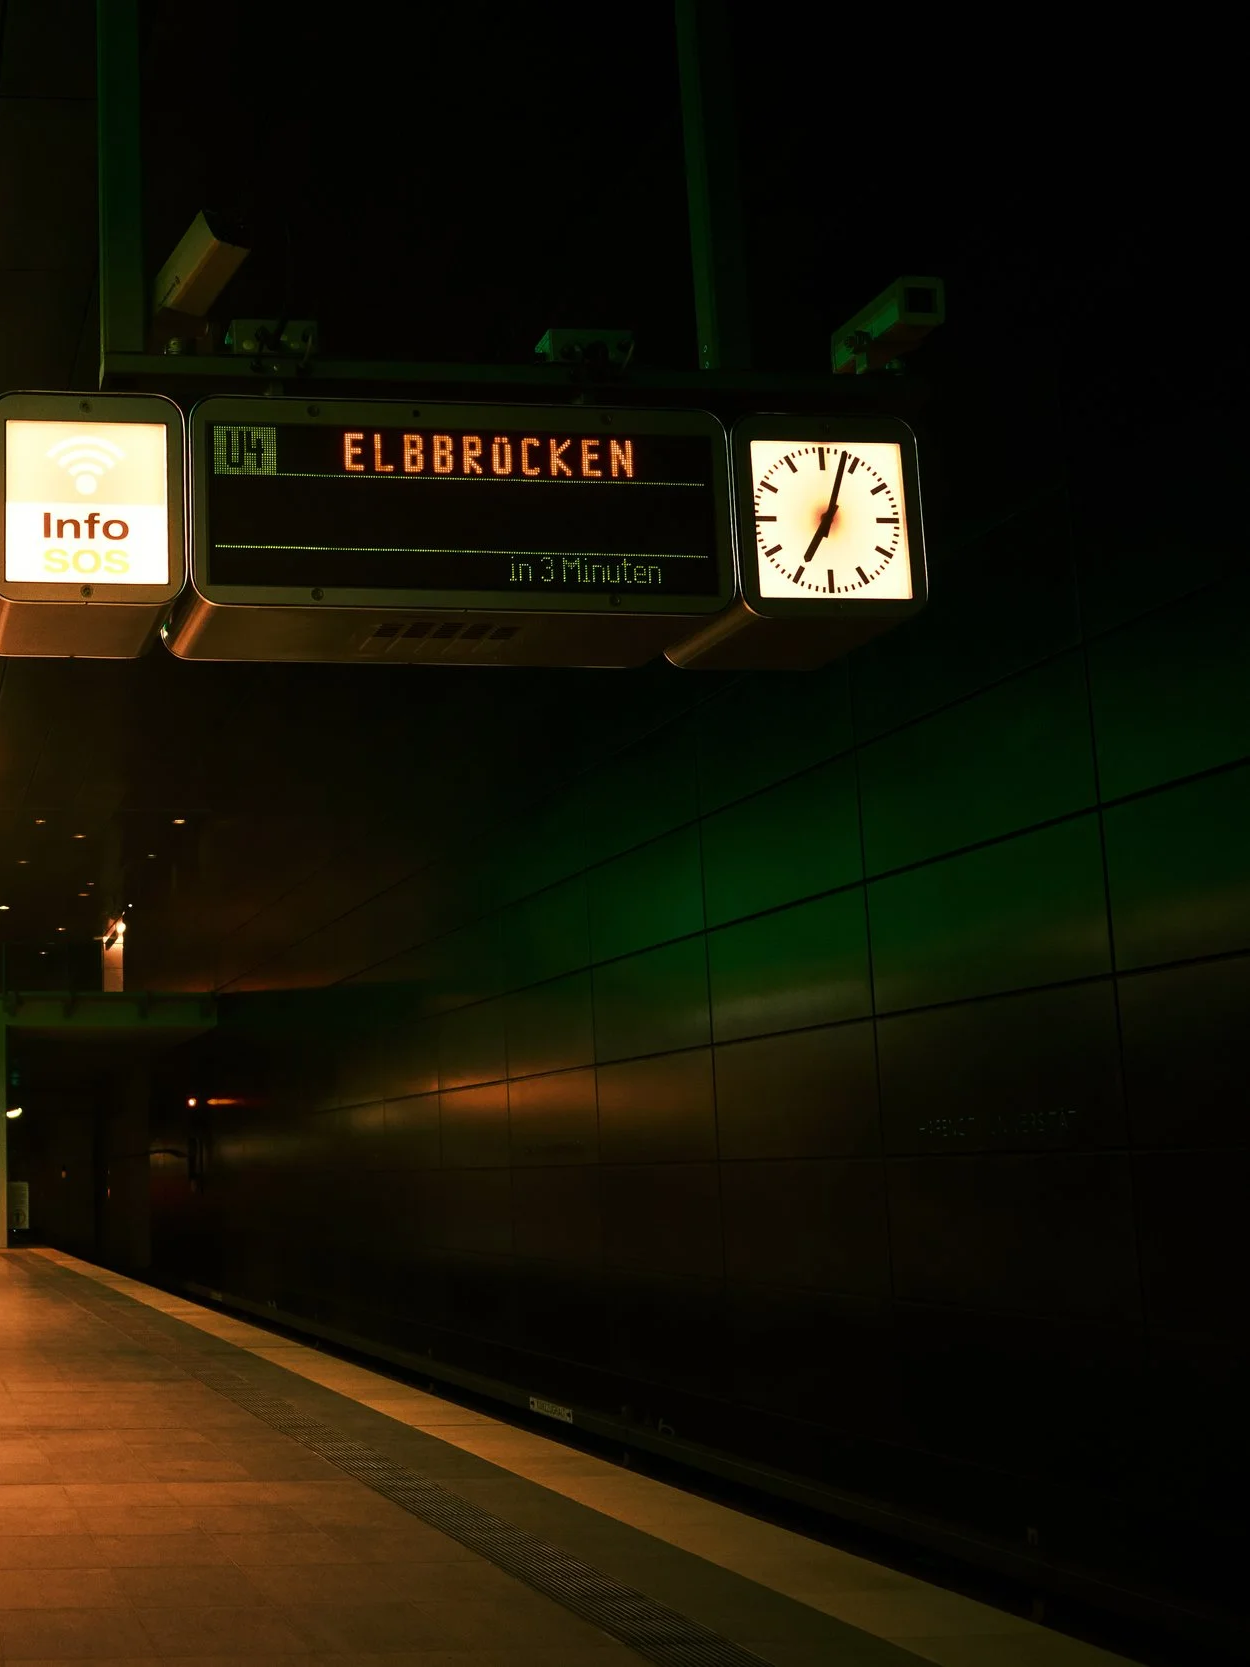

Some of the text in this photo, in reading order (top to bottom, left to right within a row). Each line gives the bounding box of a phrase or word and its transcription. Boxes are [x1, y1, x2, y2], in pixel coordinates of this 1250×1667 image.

[225, 430, 634, 479] U4 ELBBRÜCKEN
[43, 512, 130, 541] Info
[43, 548, 131, 575] SOS
[509, 555, 663, 585] in 3 Minuten
